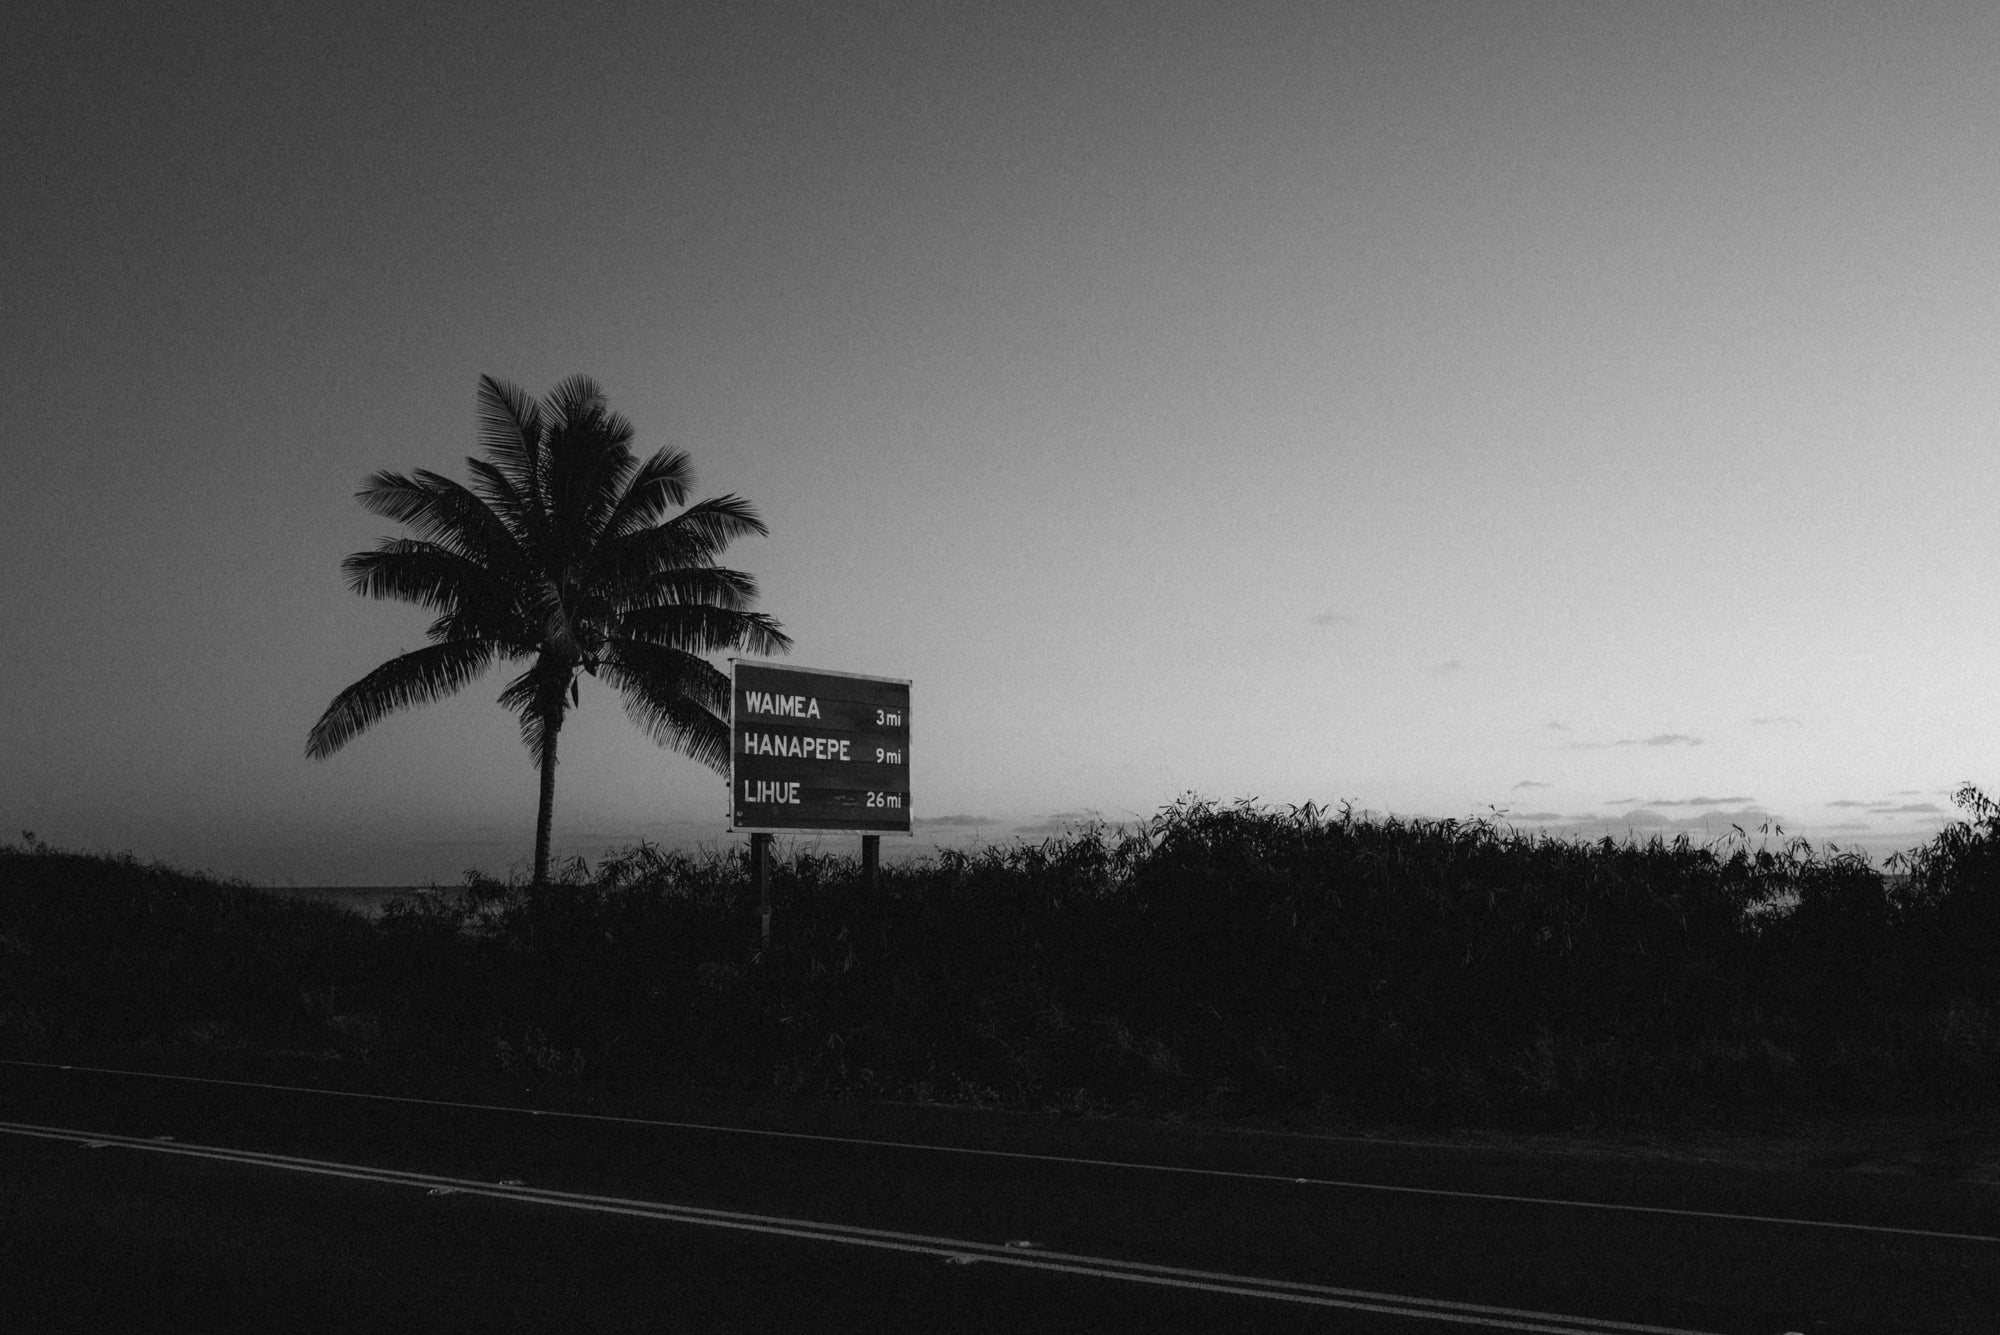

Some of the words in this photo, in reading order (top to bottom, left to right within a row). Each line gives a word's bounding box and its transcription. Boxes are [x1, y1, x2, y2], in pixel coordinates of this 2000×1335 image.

[745, 690, 821, 719] WAIMEA
[744, 732, 851, 761] HANAPEPE
[744, 779, 801, 804] LIHUE
